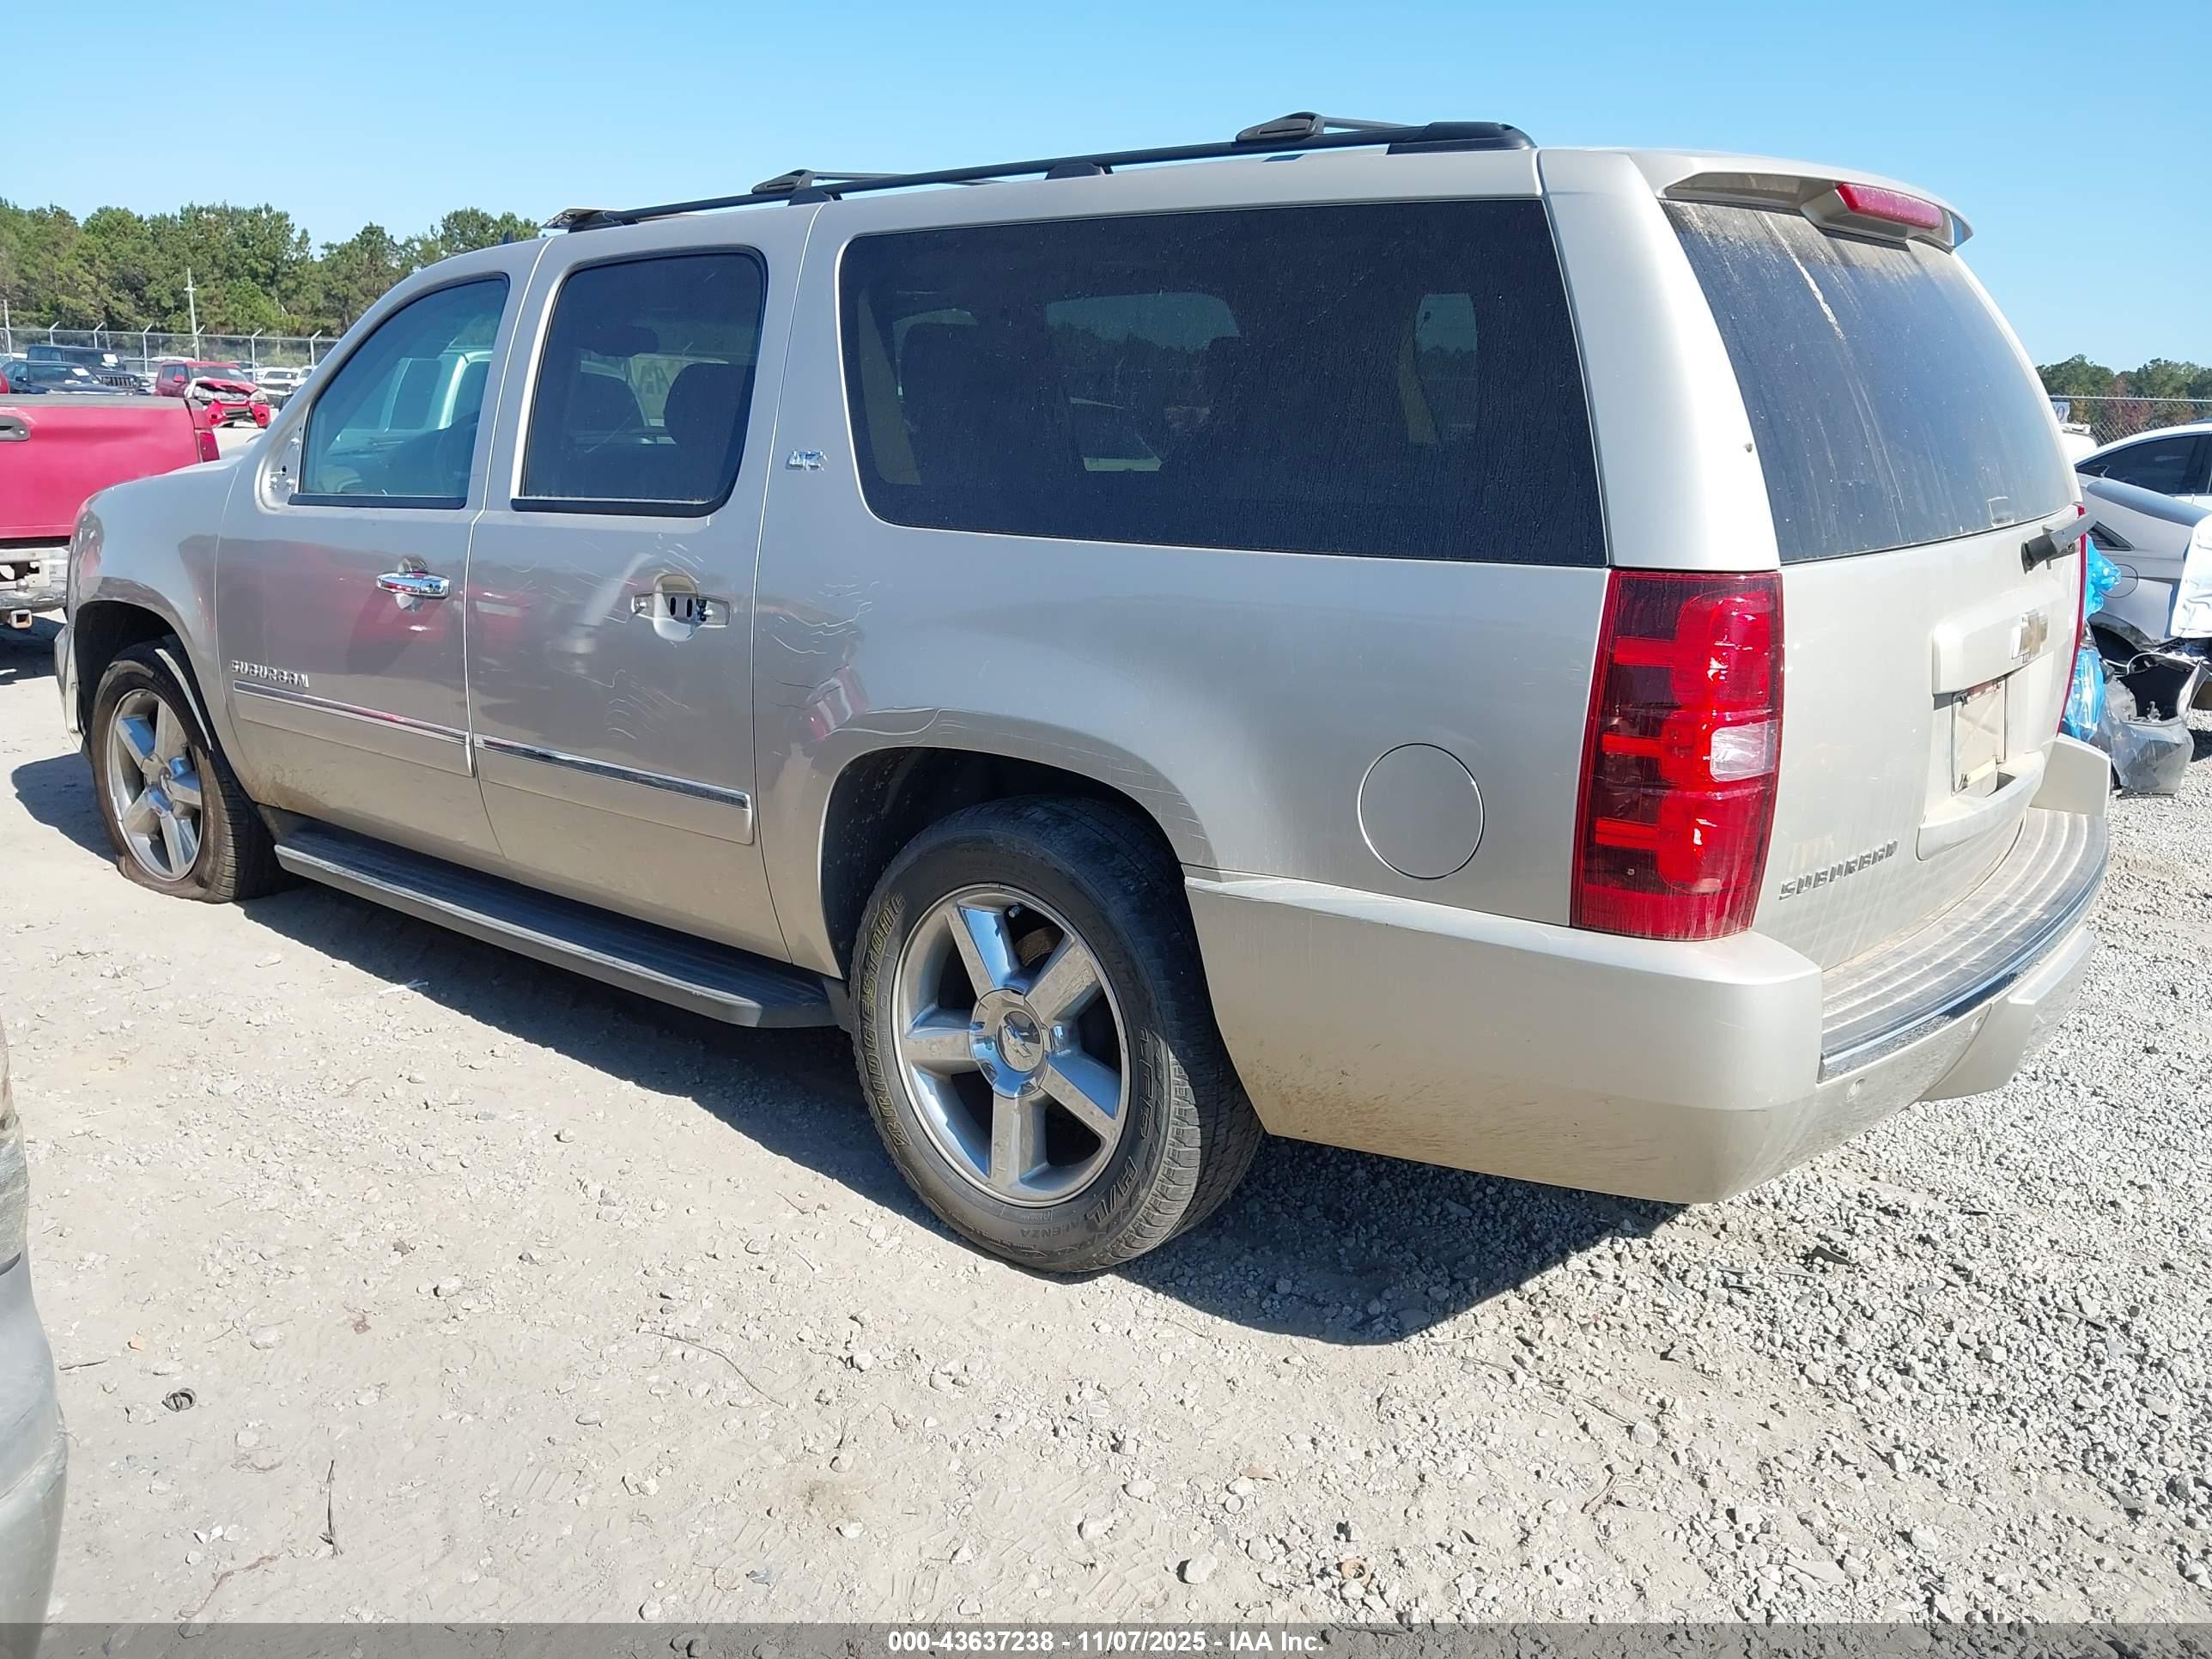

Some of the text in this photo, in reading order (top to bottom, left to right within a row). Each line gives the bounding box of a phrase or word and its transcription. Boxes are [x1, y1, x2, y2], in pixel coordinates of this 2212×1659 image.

[231, 659, 309, 688] SUBURBAN
[1778, 840, 1899, 901] SUBURBAN
[861, 891, 912, 1147] BRIDGESTONE
[1086, 1156, 1139, 1224] H/L
